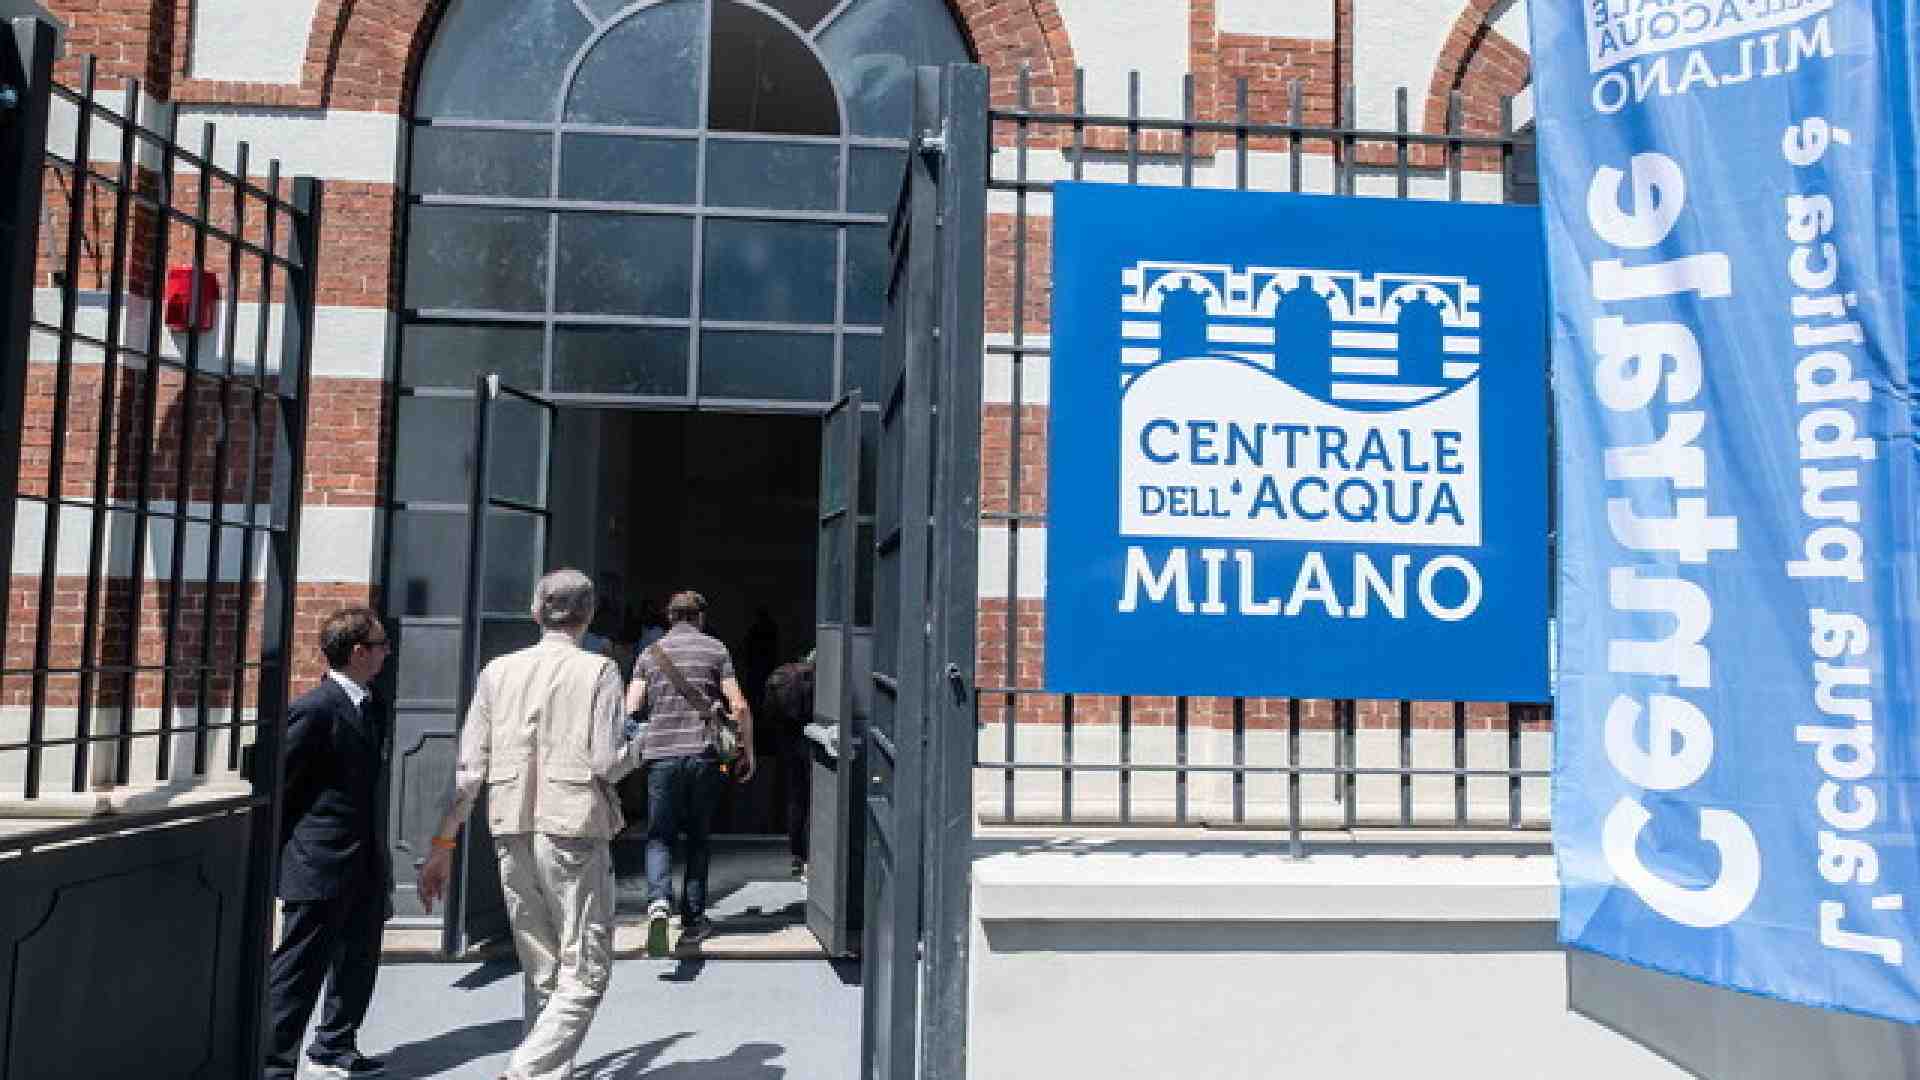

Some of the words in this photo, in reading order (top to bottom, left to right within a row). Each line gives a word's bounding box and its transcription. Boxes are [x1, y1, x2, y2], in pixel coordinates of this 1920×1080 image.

[1139, 419, 1465, 475] CENTRALE
[1139, 475, 1465, 526] DELL'ACQUA
[1118, 546, 1483, 622] MILANO
